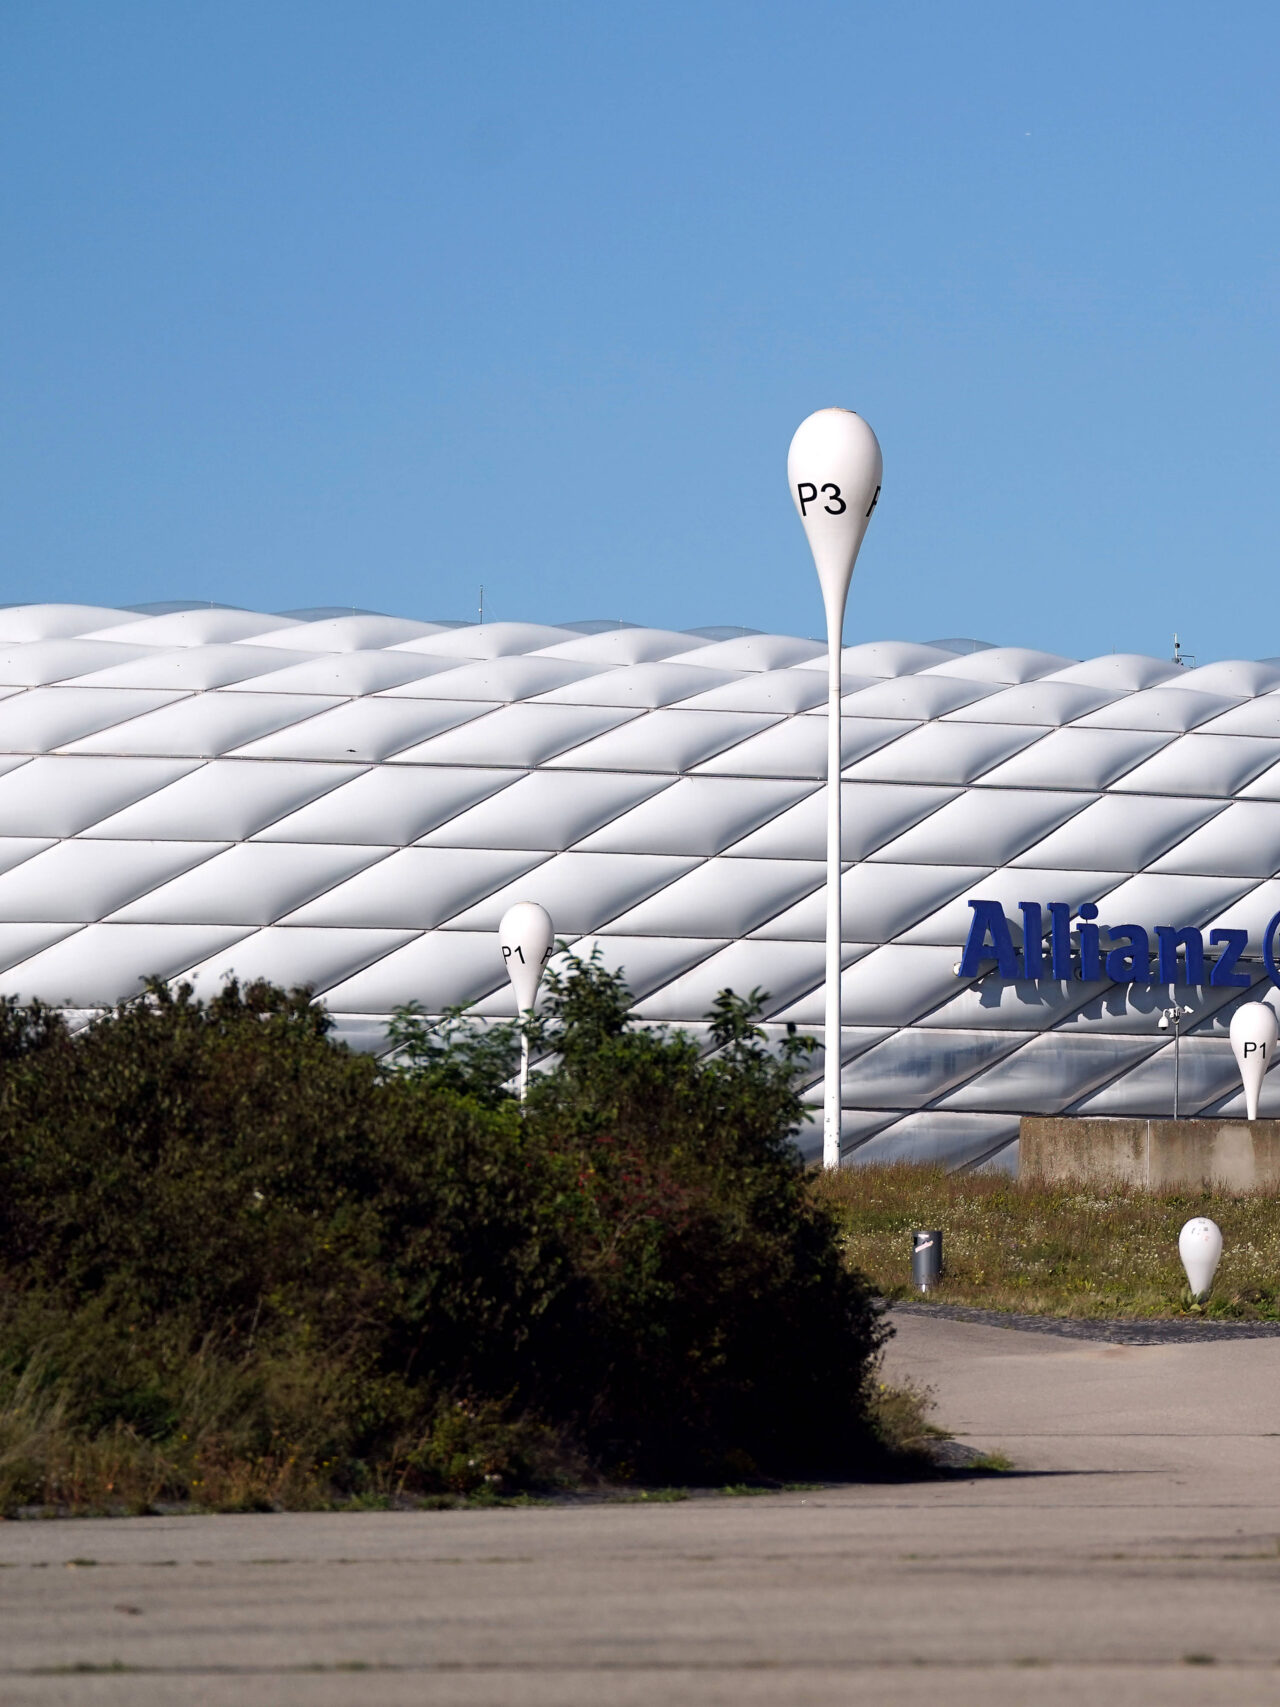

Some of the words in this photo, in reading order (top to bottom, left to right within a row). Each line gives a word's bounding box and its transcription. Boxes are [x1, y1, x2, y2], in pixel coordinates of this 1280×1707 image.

[797, 482, 847, 517] P3
[501, 945, 526, 966] P1
[957, 899, 1252, 987] Allianz
[1243, 1041, 1267, 1059] P1
